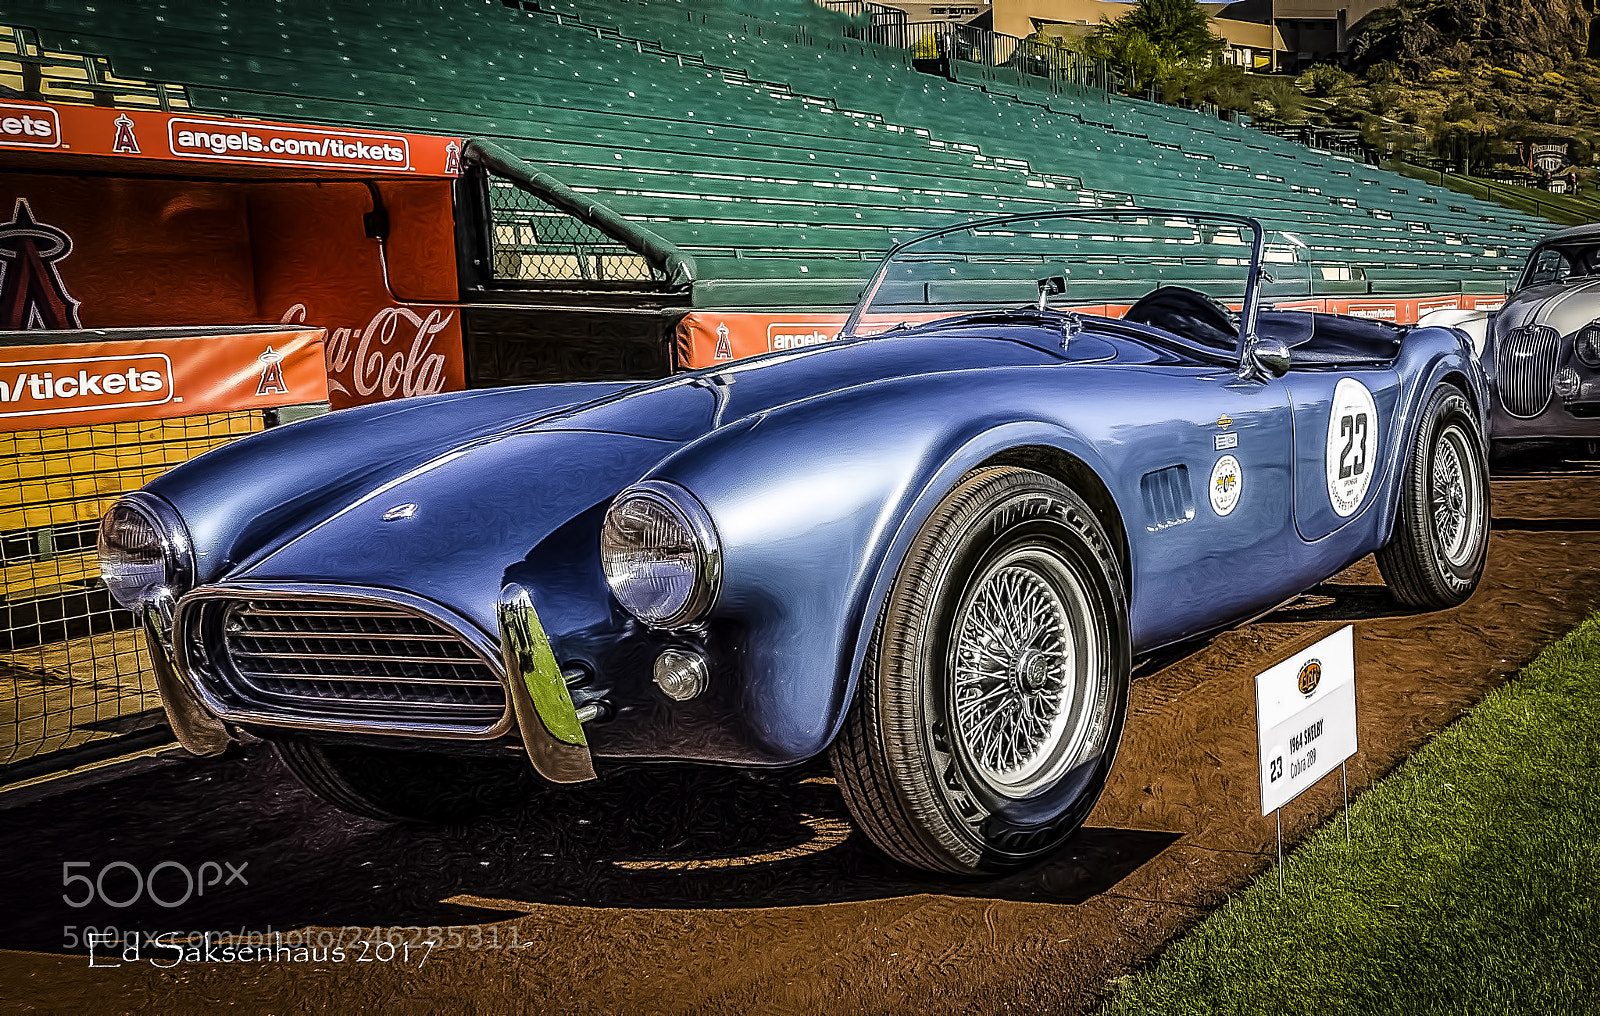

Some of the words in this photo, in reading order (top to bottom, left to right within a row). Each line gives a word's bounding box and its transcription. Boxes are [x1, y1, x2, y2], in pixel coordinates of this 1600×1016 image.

[0, 115, 52, 137] ets
[177, 130, 404, 162] angels.com/tickets
[281, 304, 454, 397] a-Cola
[1339, 413, 1367, 479] 23
[1289, 732, 1302, 755] 1964
[1304, 718, 1323, 746] SHELBY
[1270, 756, 1283, 783] 23
[1291, 758, 1306, 779] Cobra
